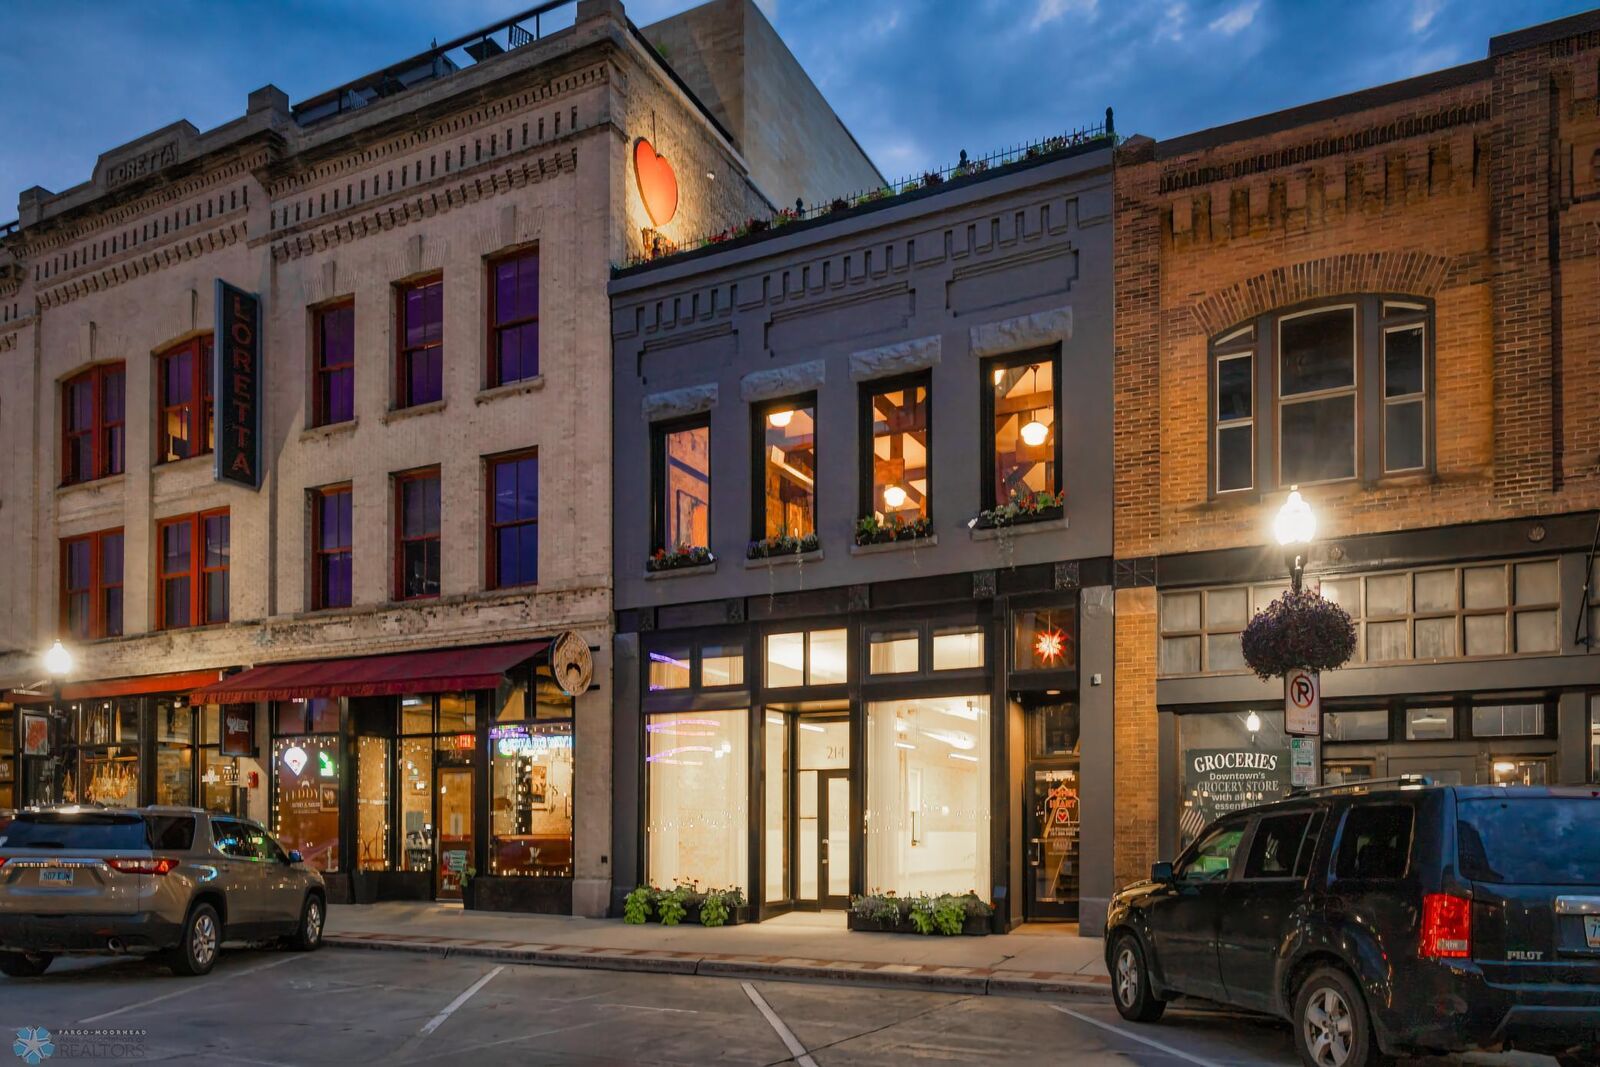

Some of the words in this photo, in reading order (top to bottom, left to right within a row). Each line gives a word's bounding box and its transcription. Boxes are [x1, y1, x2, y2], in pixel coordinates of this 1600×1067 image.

[107, 140, 177, 186] LORETTA
[232, 296, 252, 476] LORETTA
[1194, 752, 1278, 773] GROCERIES
[1209, 772, 1266, 780] Downtown's
[1197, 781, 1245, 793] GROCERY
[1245, 780, 1279, 792] STORE
[1211, 792, 1232, 801] with
[1507, 951, 1544, 960] PILOT
